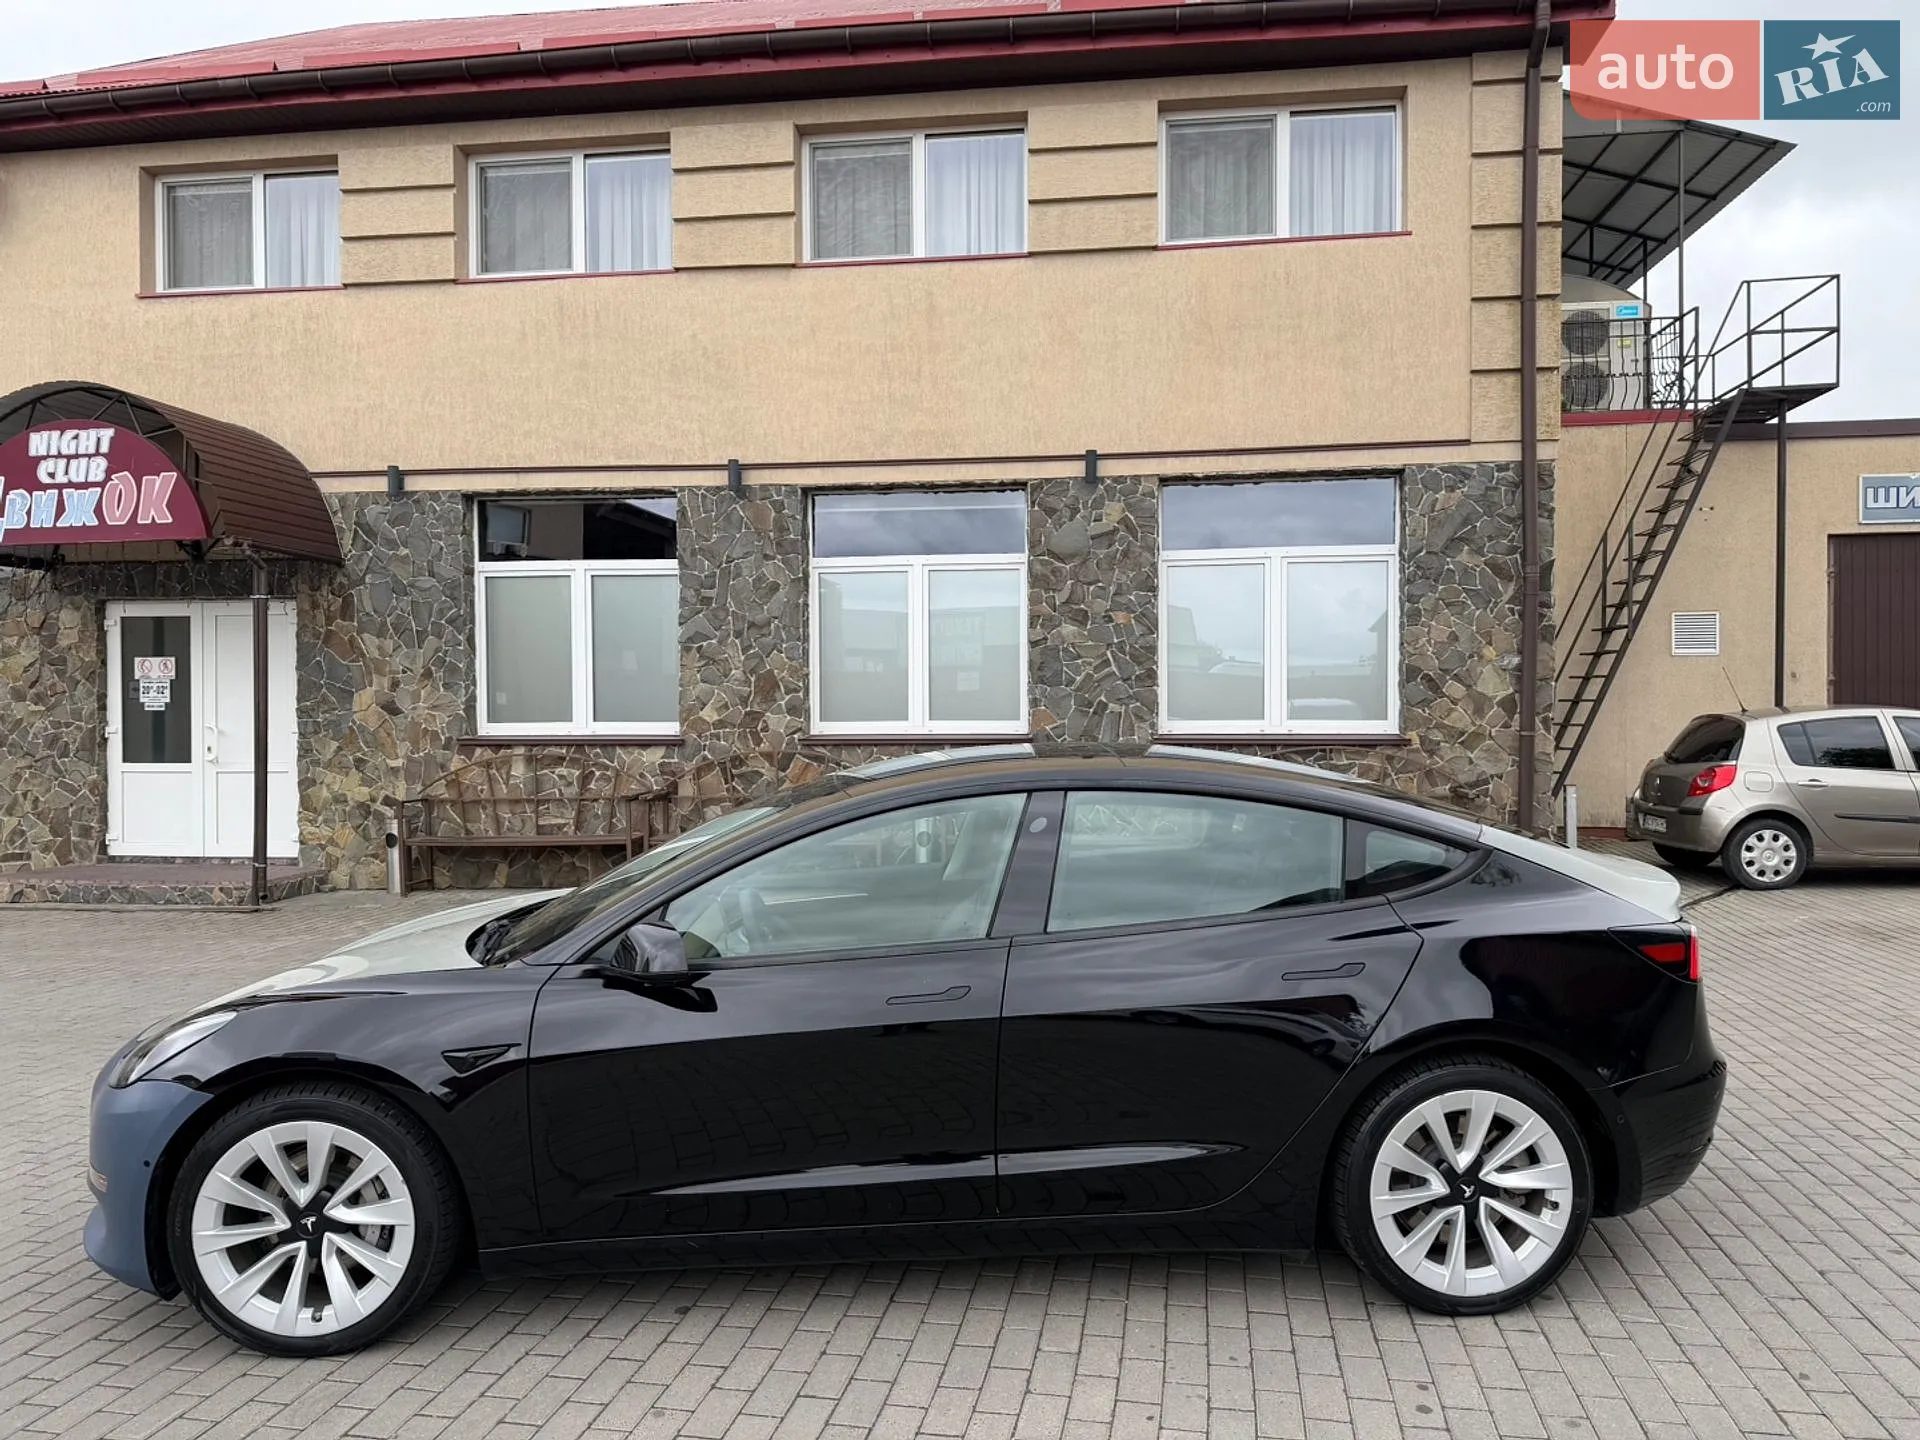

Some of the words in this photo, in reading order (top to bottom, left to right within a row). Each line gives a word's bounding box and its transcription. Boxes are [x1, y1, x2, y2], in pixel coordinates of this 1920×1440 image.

[28, 428, 115, 457] NIGHT
[37, 456, 109, 484] CLUB
[0, 471, 177, 543] ВИЖОК
